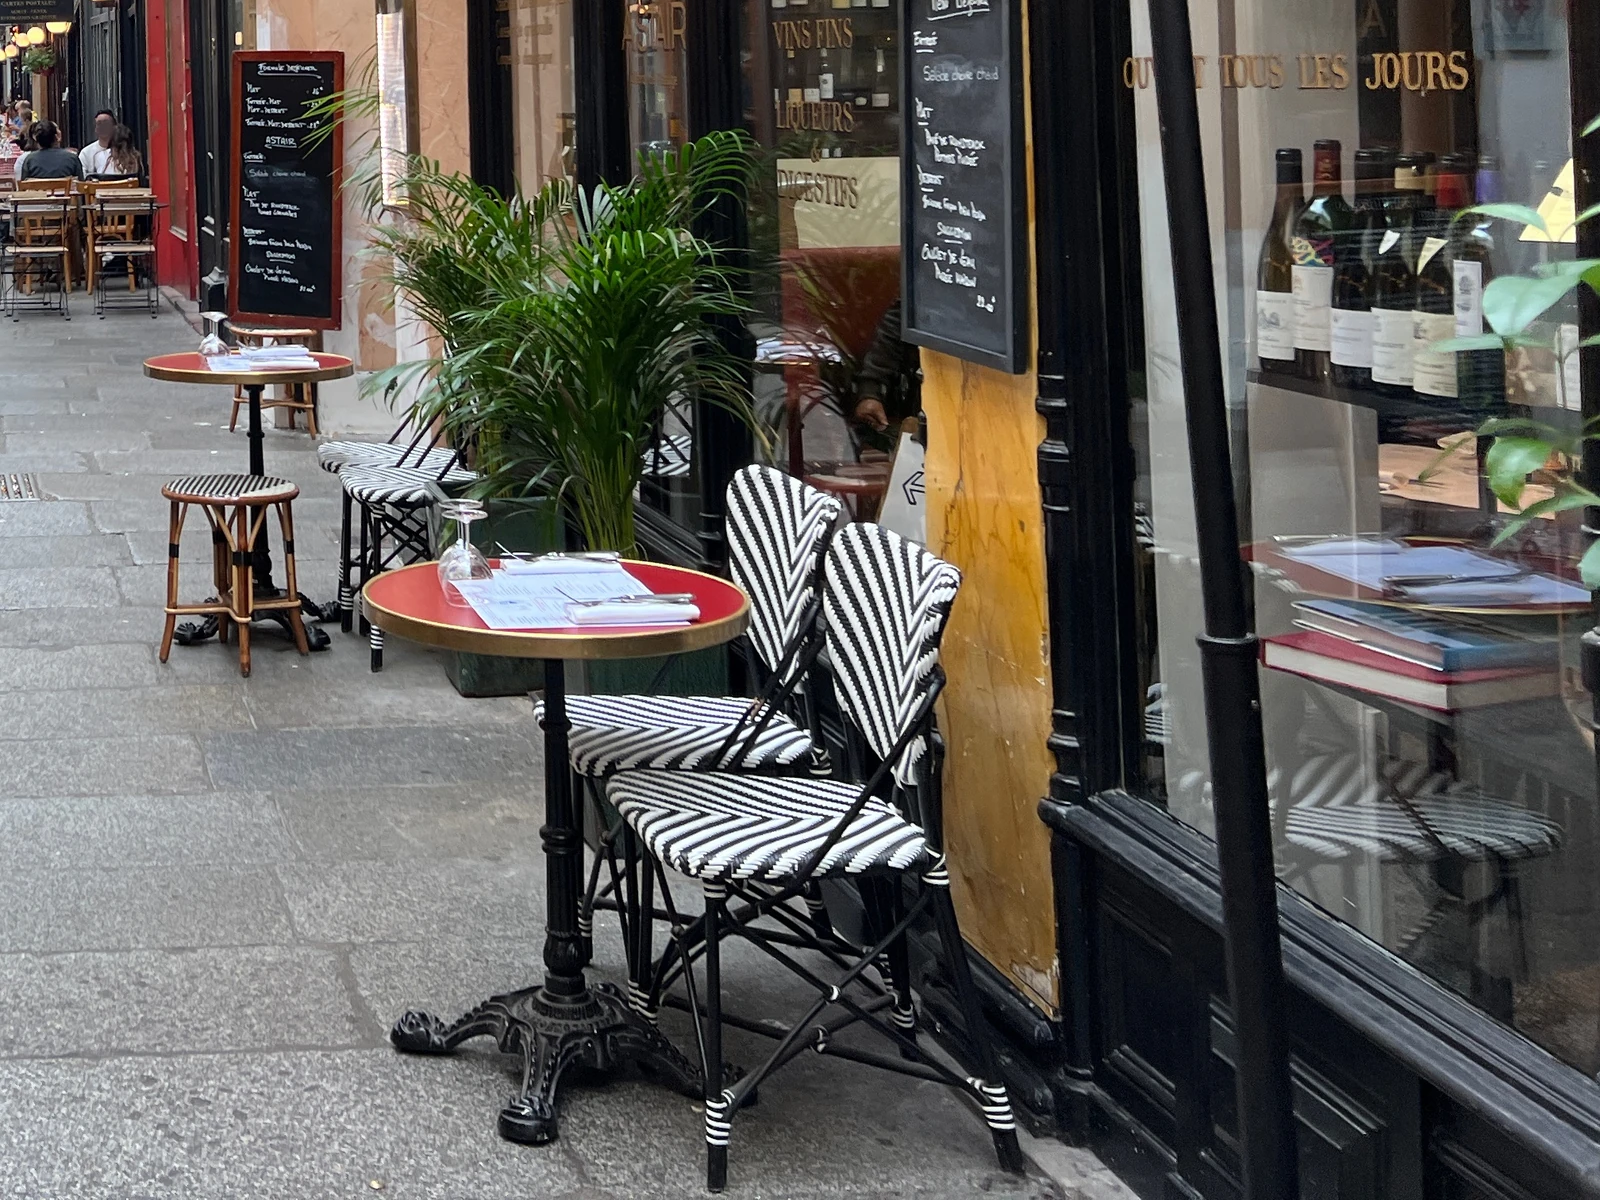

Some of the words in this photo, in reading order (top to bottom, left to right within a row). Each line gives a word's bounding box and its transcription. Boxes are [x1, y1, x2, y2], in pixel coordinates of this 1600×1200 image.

[773, 19, 812, 51] VINS
[816, 18, 854, 49] FINS
[1220, 53, 1284, 89] TOUS
[1297, 52, 1350, 90] LES
[1365, 50, 1470, 92] JOURS
[775, 99, 855, 134] LIQUEURS
